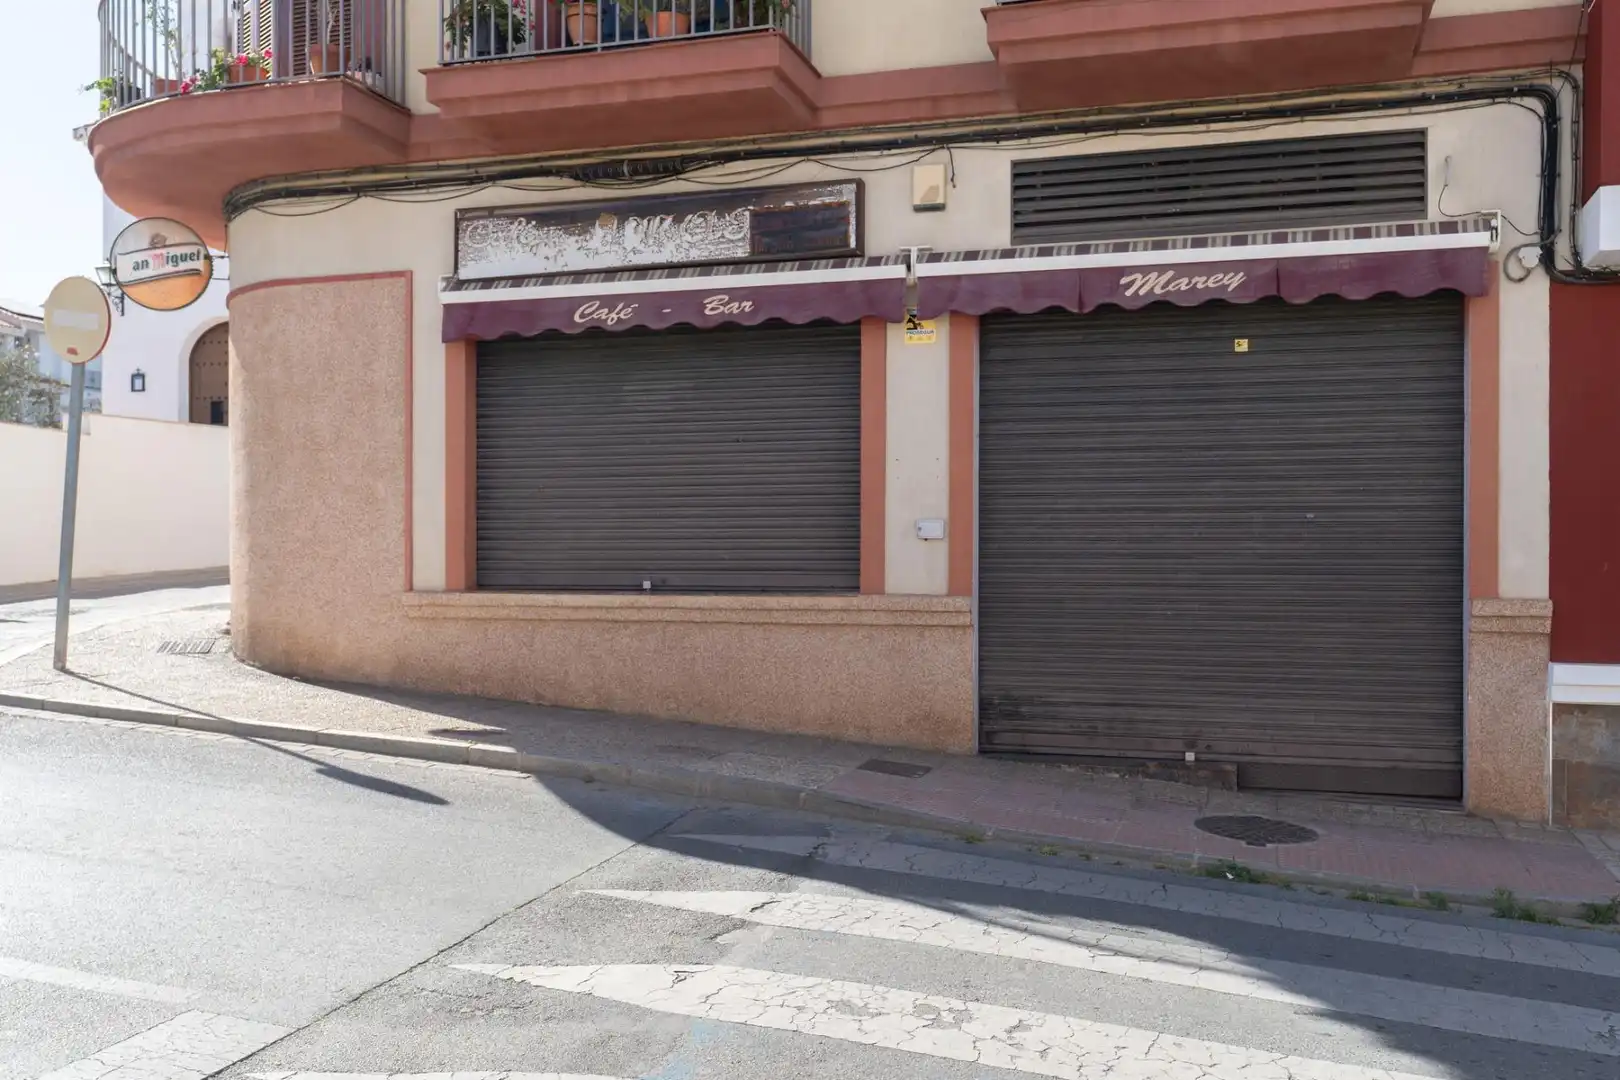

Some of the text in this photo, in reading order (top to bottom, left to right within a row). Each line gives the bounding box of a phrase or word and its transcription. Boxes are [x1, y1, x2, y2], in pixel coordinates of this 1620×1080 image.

[152, 248, 201, 269] Miguel
[1119, 270, 1247, 297] Marey
[573, 300, 639, 326] Café
[703, 294, 755, 316] Bar
